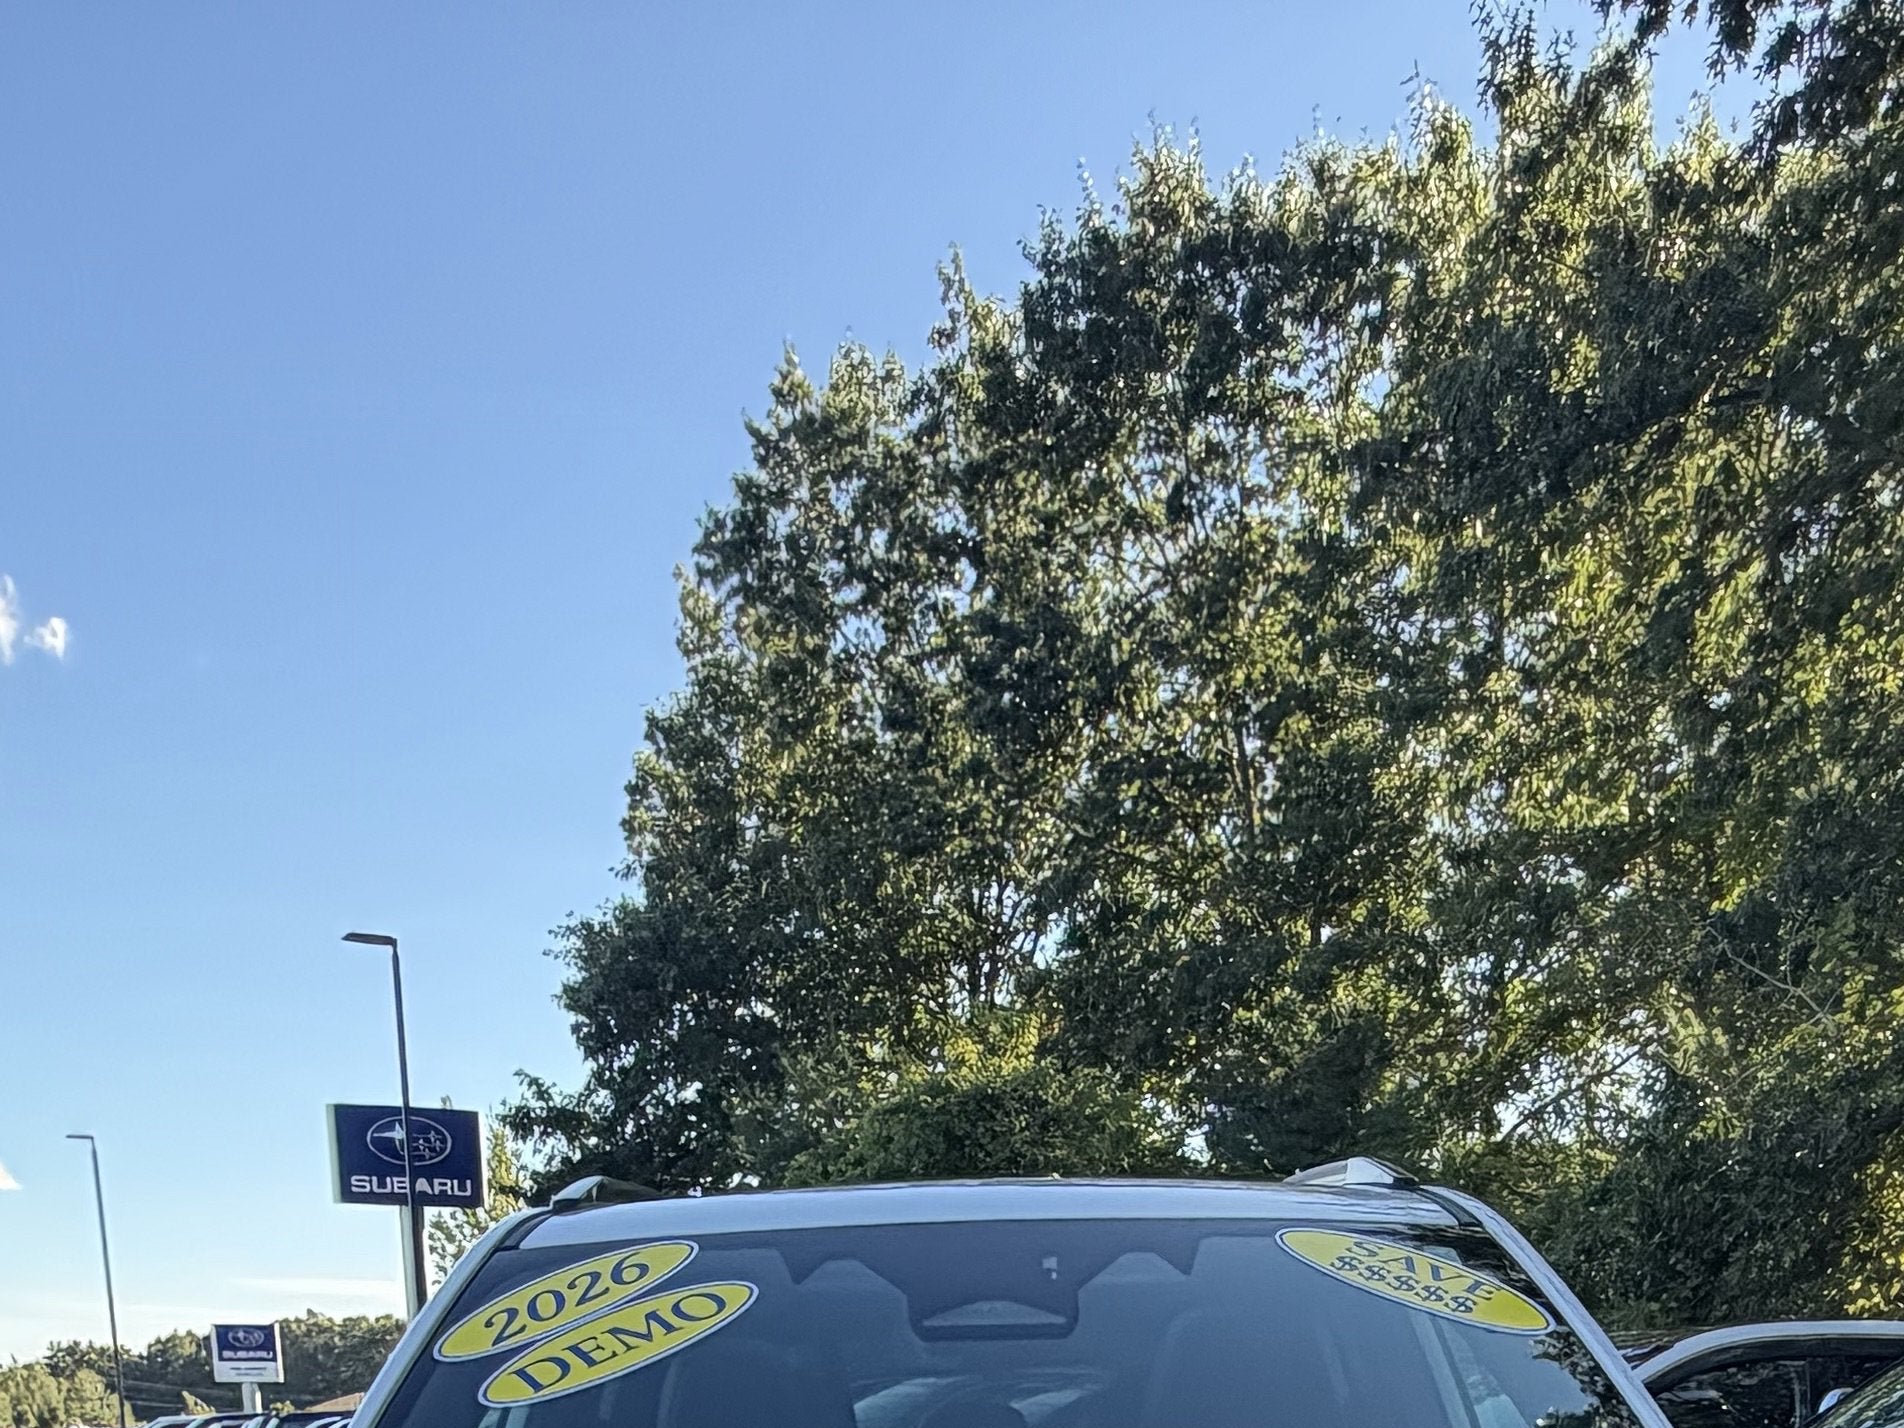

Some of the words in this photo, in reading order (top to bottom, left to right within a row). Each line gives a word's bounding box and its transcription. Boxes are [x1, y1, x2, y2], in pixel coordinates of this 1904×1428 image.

[350, 1174, 472, 1197] SUBARU
[483, 1251, 651, 1348] 2026
[1346, 1240, 1501, 1301] SAVE
[507, 1292, 727, 1394] DEMO
